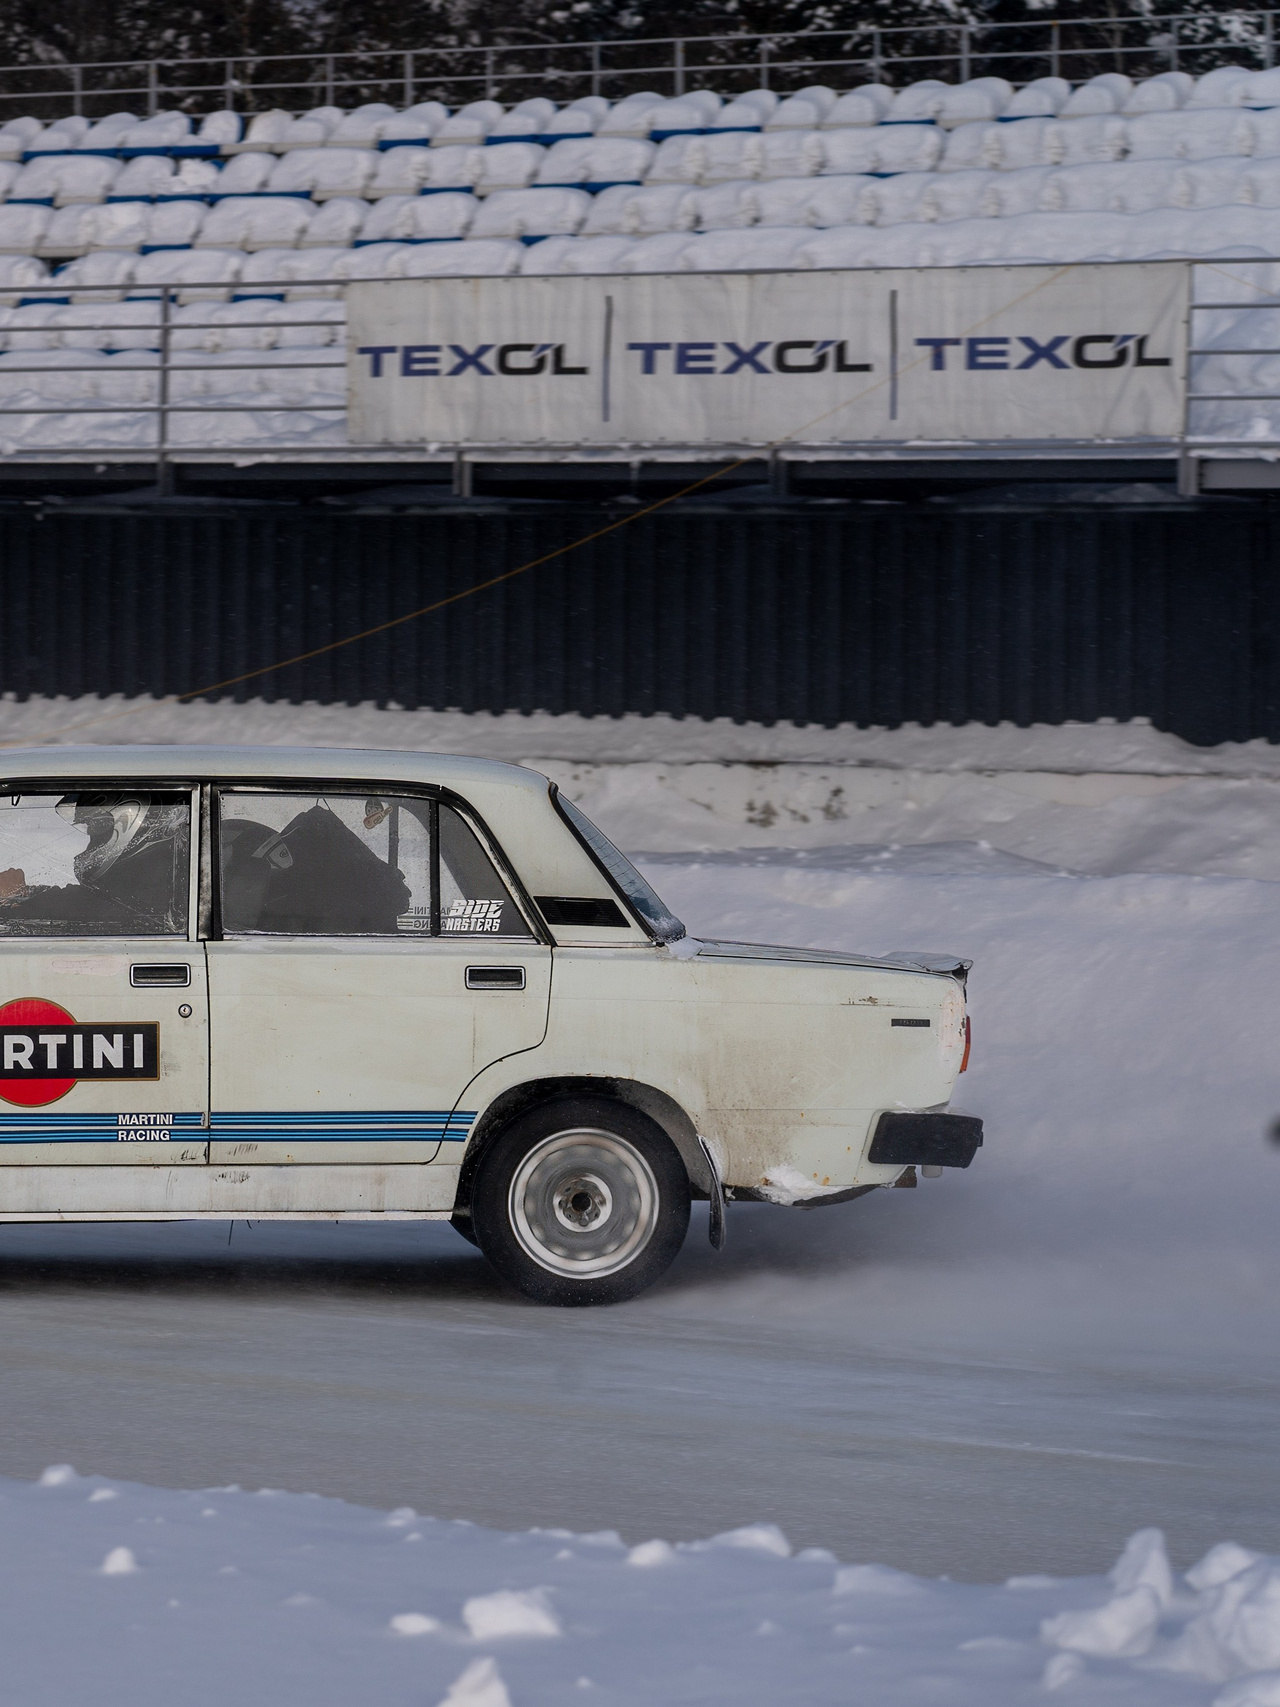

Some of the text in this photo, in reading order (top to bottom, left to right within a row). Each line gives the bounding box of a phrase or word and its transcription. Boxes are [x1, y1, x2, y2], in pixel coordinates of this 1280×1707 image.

[357, 334, 1173, 378] TEXOL TEXOL TEXOL
[446, 918, 501, 932] MASTERS
[118, 1114, 173, 1125] MARTINI
[118, 1130, 170, 1141] RACING
